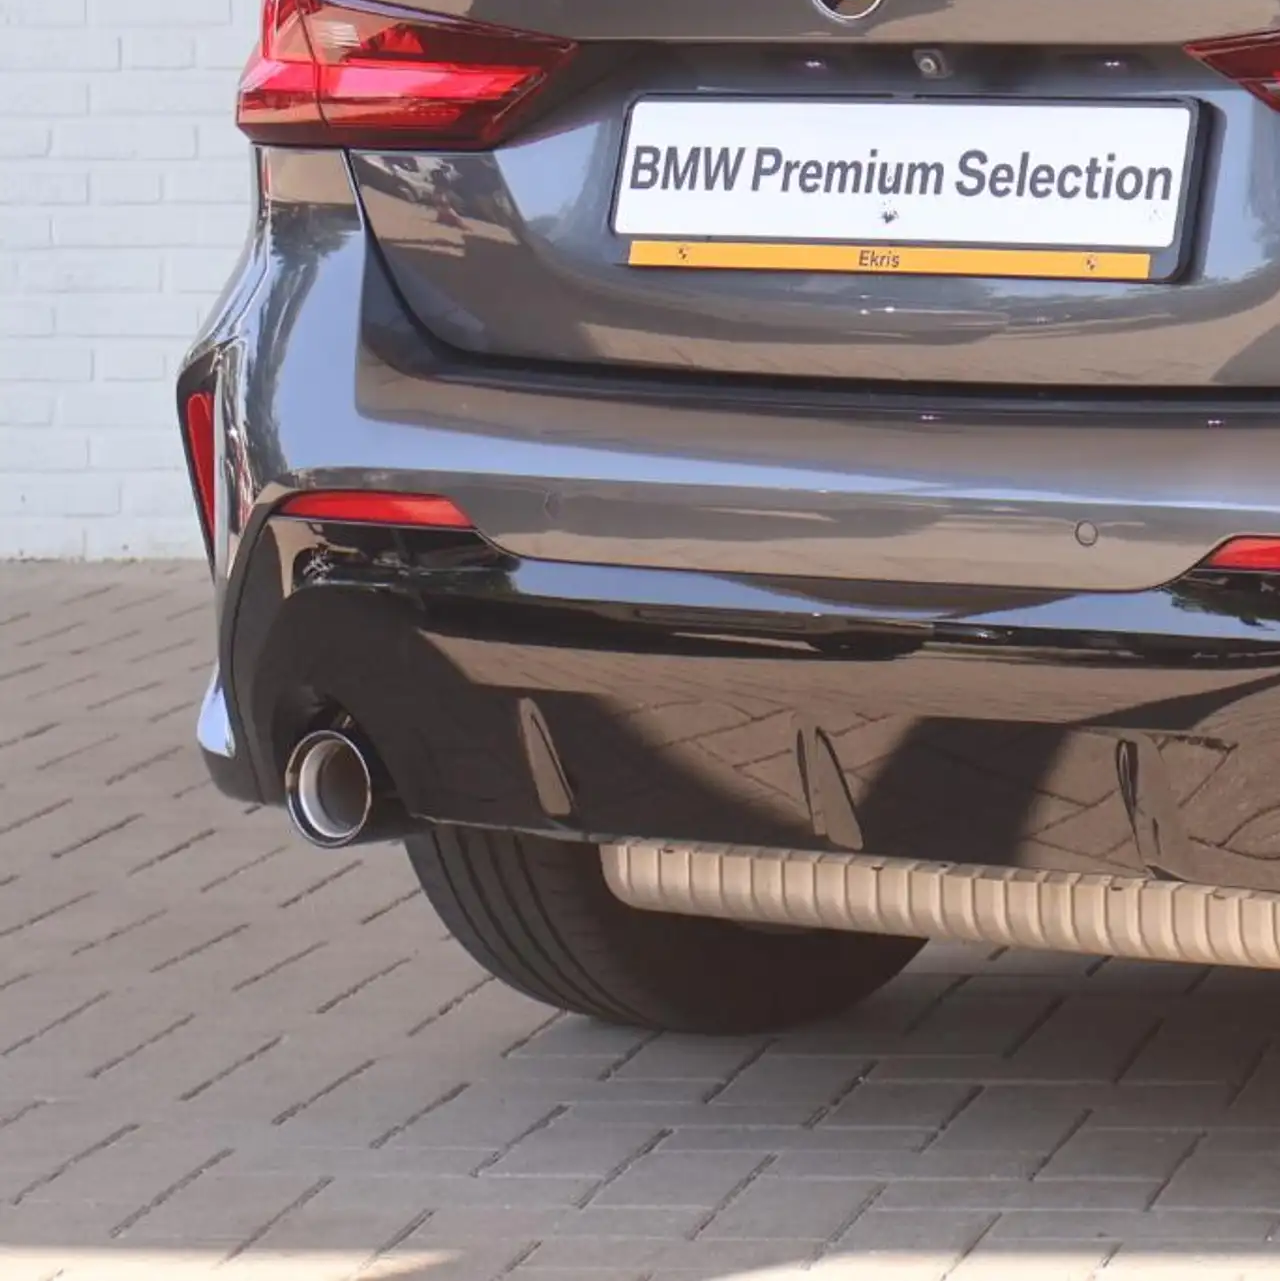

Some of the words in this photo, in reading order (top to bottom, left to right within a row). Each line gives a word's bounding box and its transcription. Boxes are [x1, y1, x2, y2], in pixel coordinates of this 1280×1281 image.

[629, 145, 746, 190] BMW
[751, 146, 945, 196] Premium
[955, 148, 1173, 201] Selection
[858, 249, 900, 269] Ekris
